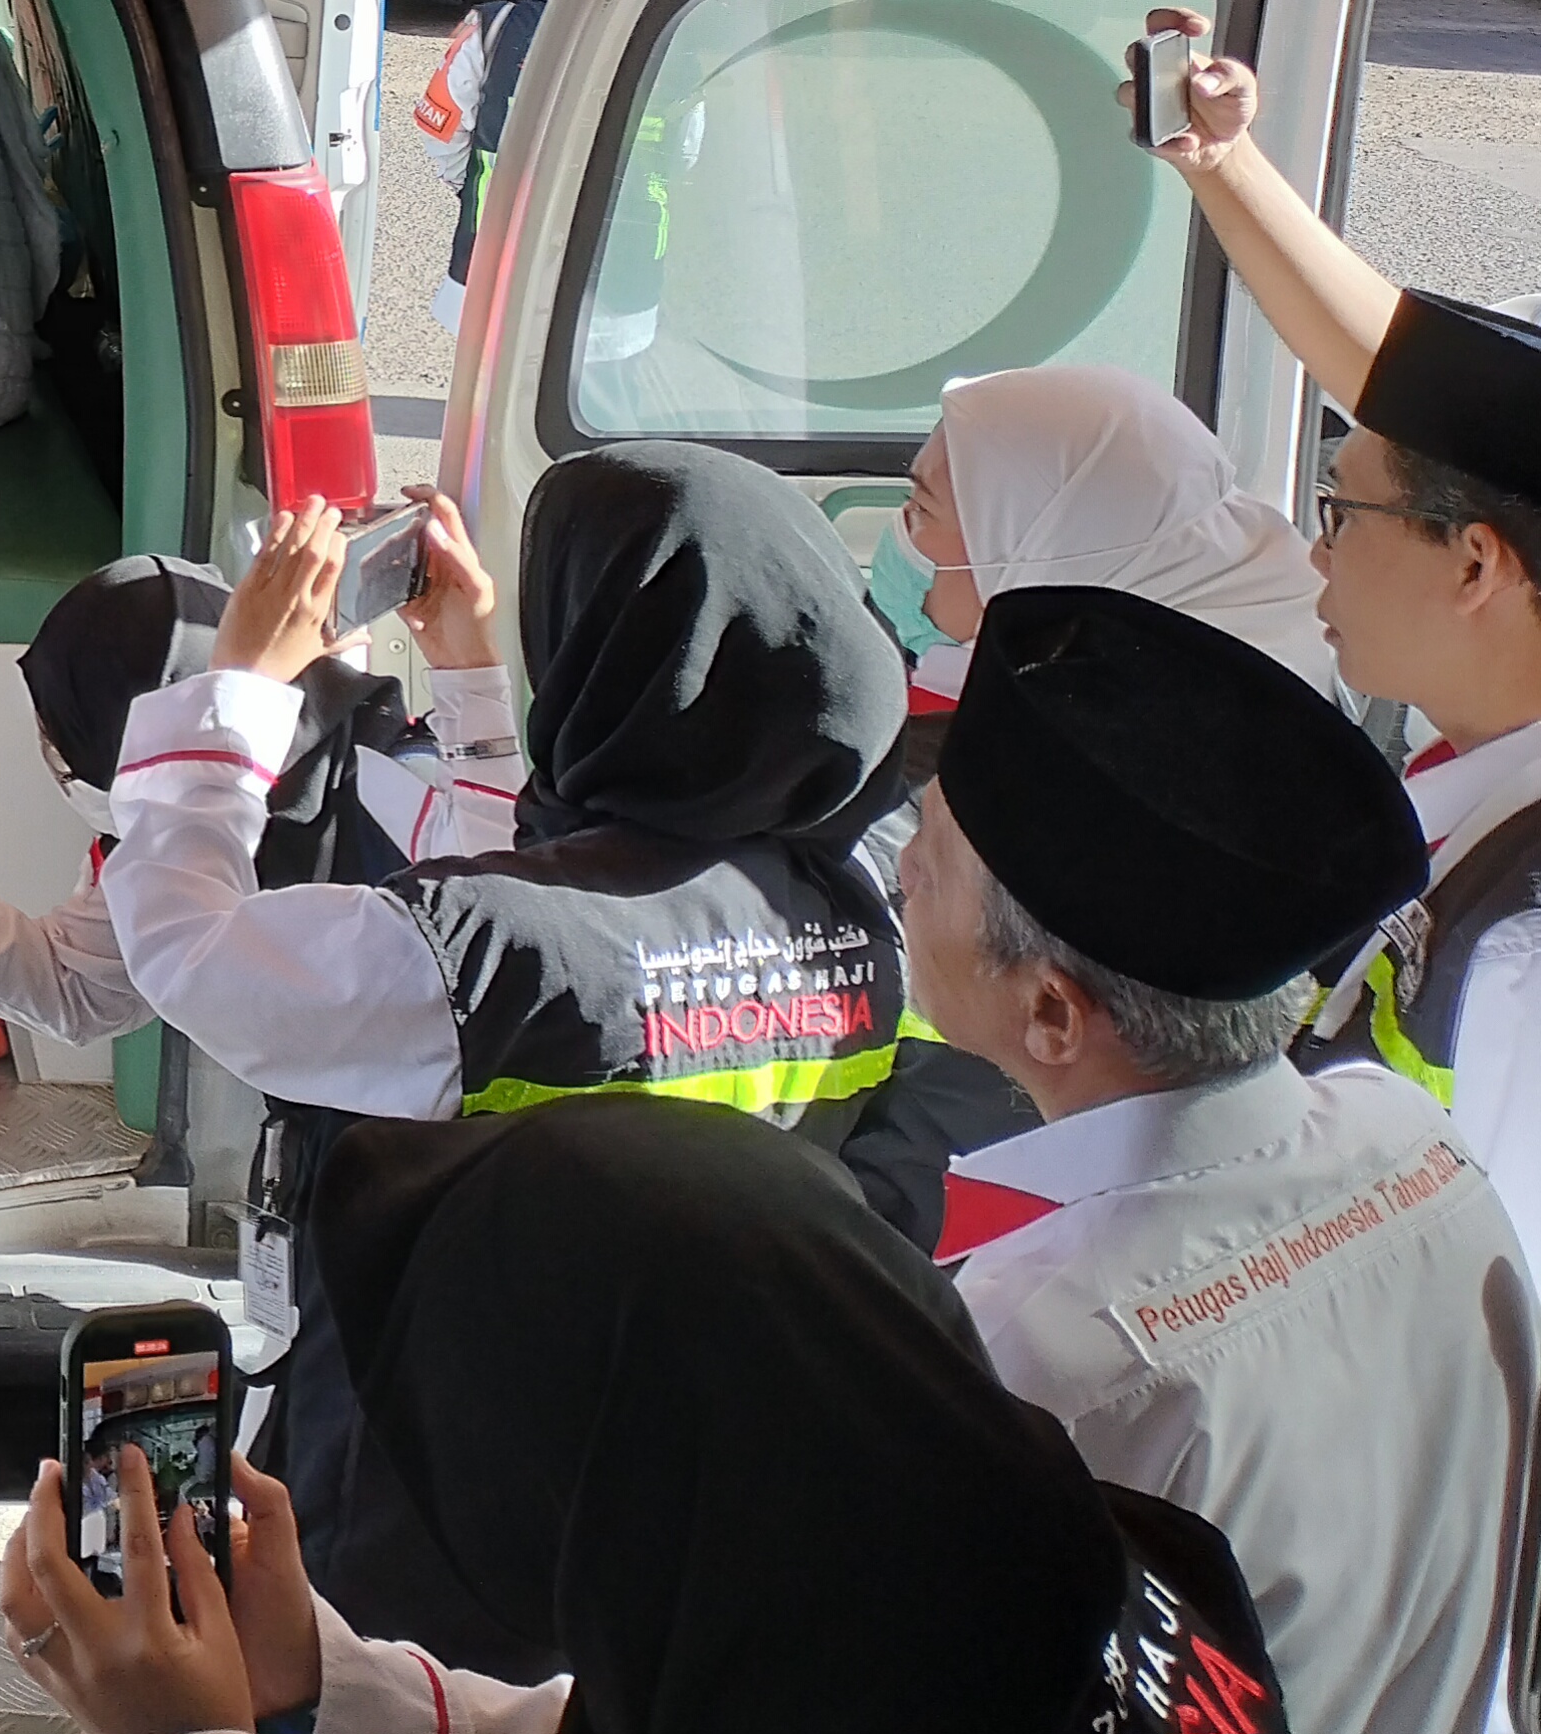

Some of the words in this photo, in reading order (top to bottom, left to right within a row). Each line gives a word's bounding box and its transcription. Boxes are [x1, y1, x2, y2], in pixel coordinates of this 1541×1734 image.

[644, 968, 802, 1006] PETUGAS
[815, 961, 875, 990] HAJI
[646, 991, 874, 1056] INDONESIA
[1135, 1271, 1249, 1343] Petugas
[1240, 1241, 1292, 1294] Haji
[1281, 1195, 1386, 1272] Indonesia
[1373, 1166, 1440, 1217] Tahun
[1135, 1569, 1182, 1720] HAJI
